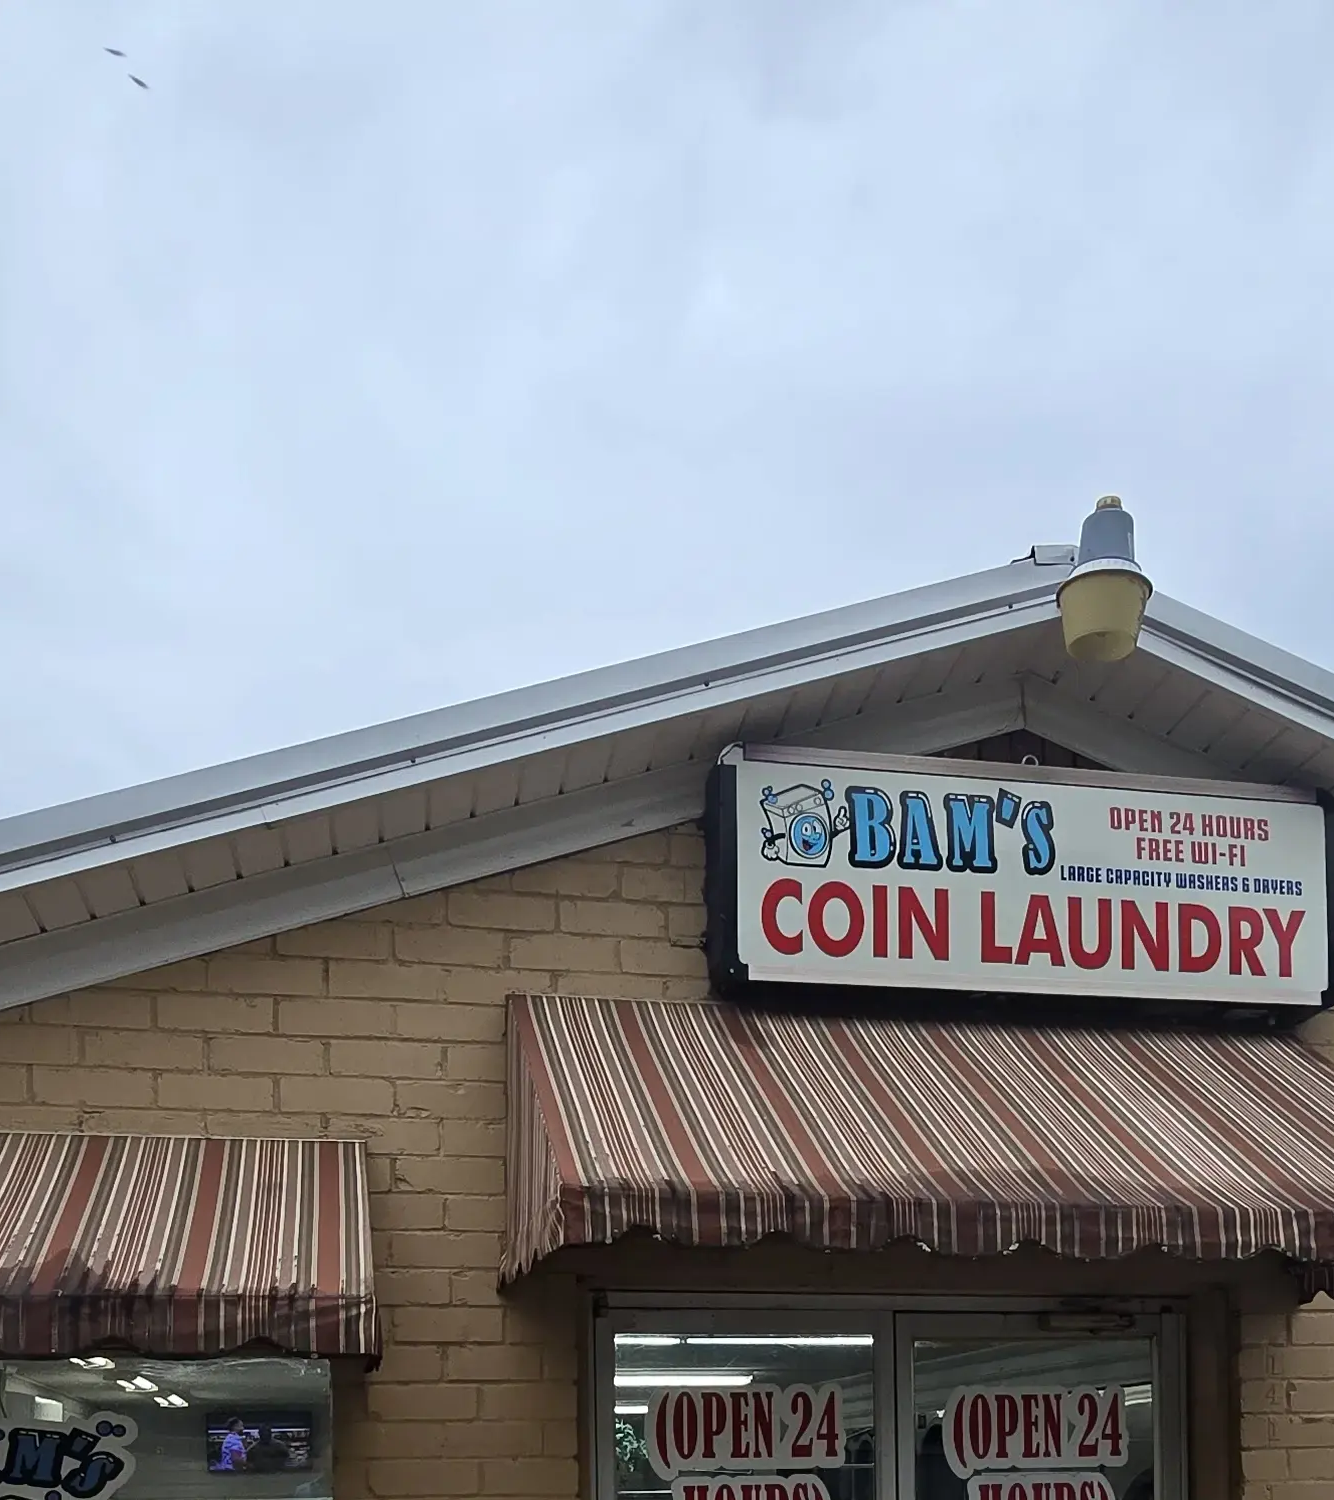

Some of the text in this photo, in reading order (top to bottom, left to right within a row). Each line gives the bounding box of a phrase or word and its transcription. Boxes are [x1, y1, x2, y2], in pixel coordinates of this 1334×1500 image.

[844, 786, 1056, 875] BAM'S
[1109, 806, 1270, 842] OPEN 24 HOURS
[1136, 836, 1247, 868] FREE WI-FI
[1060, 864, 1103, 884] LARGE
[1106, 867, 1172, 888] CAPACITY
[1175, 873, 1239, 892] WASHERS
[1253, 878, 1303, 897] DRYERS
[761, 876, 1306, 979] COIN LAUNDRY
[655, 1390, 840, 1470] (OPEN 24
[953, 1392, 1123, 1469] (OPEN 24
